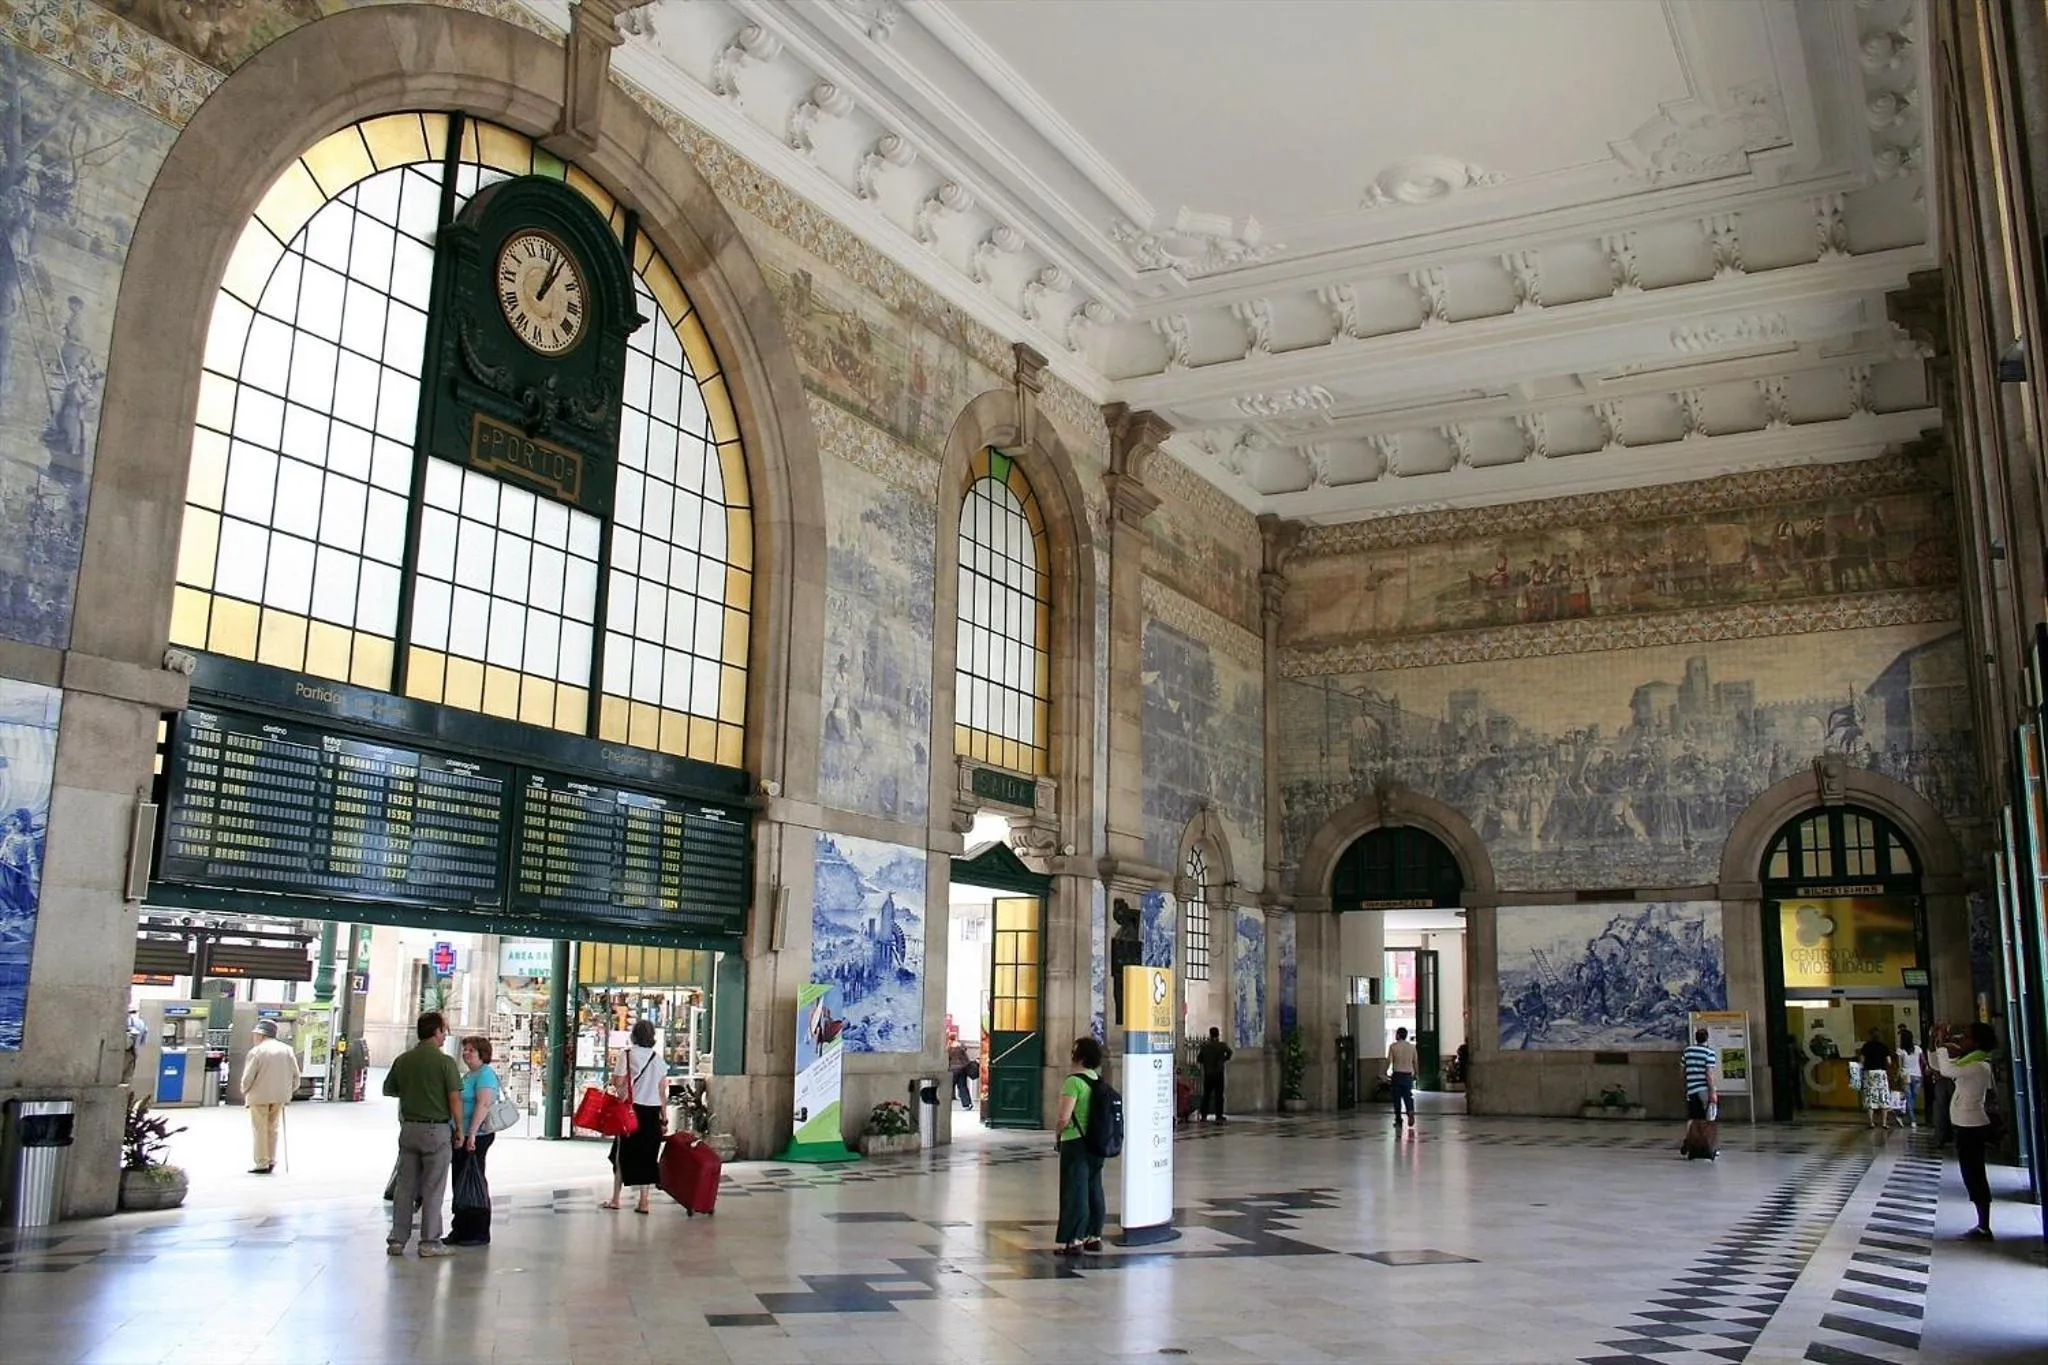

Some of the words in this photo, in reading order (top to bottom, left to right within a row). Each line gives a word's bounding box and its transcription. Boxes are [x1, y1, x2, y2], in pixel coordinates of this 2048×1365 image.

[491, 429, 565, 480] PORTO
[1790, 948, 1839, 962] CENTRO
[1841, 948, 1858, 960] DA
[1799, 960, 1884, 974] MOBILIDADE
